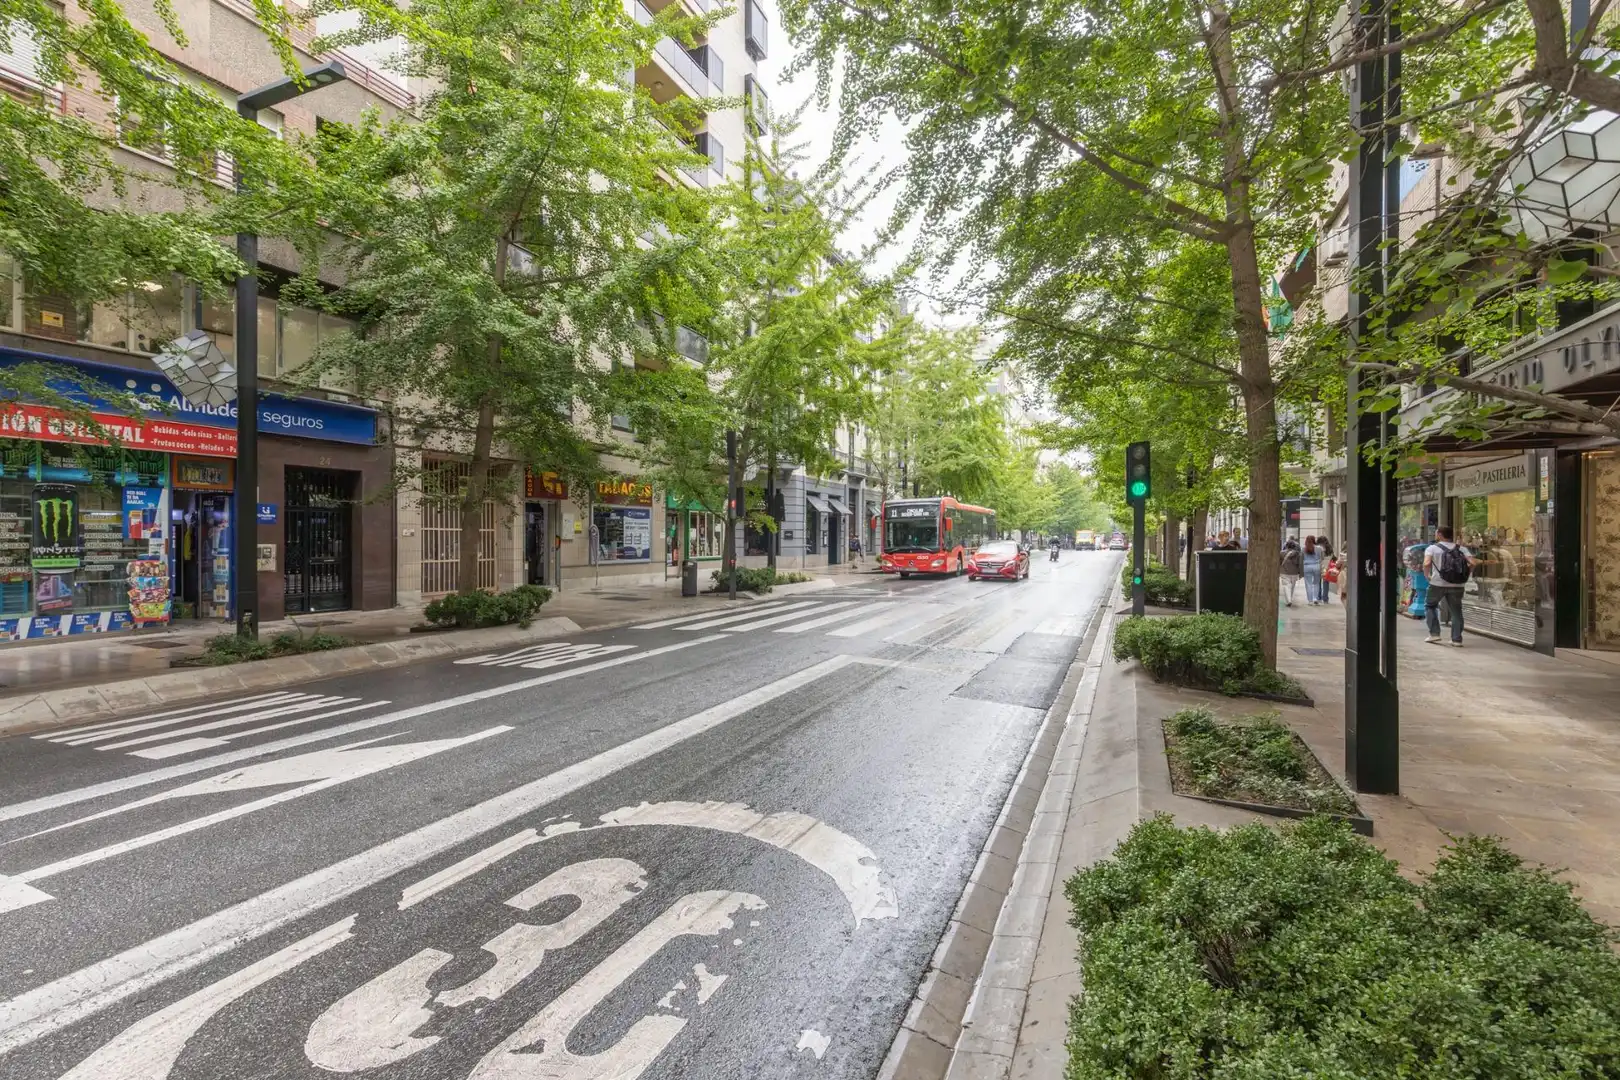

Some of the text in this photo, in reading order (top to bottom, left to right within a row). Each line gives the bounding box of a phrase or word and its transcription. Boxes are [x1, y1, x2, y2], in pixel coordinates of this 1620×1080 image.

[168, 395, 324, 429] Almude seguros
[1482, 464, 1526, 485] PASTELERIA
[599, 482, 652, 497] TABACS
